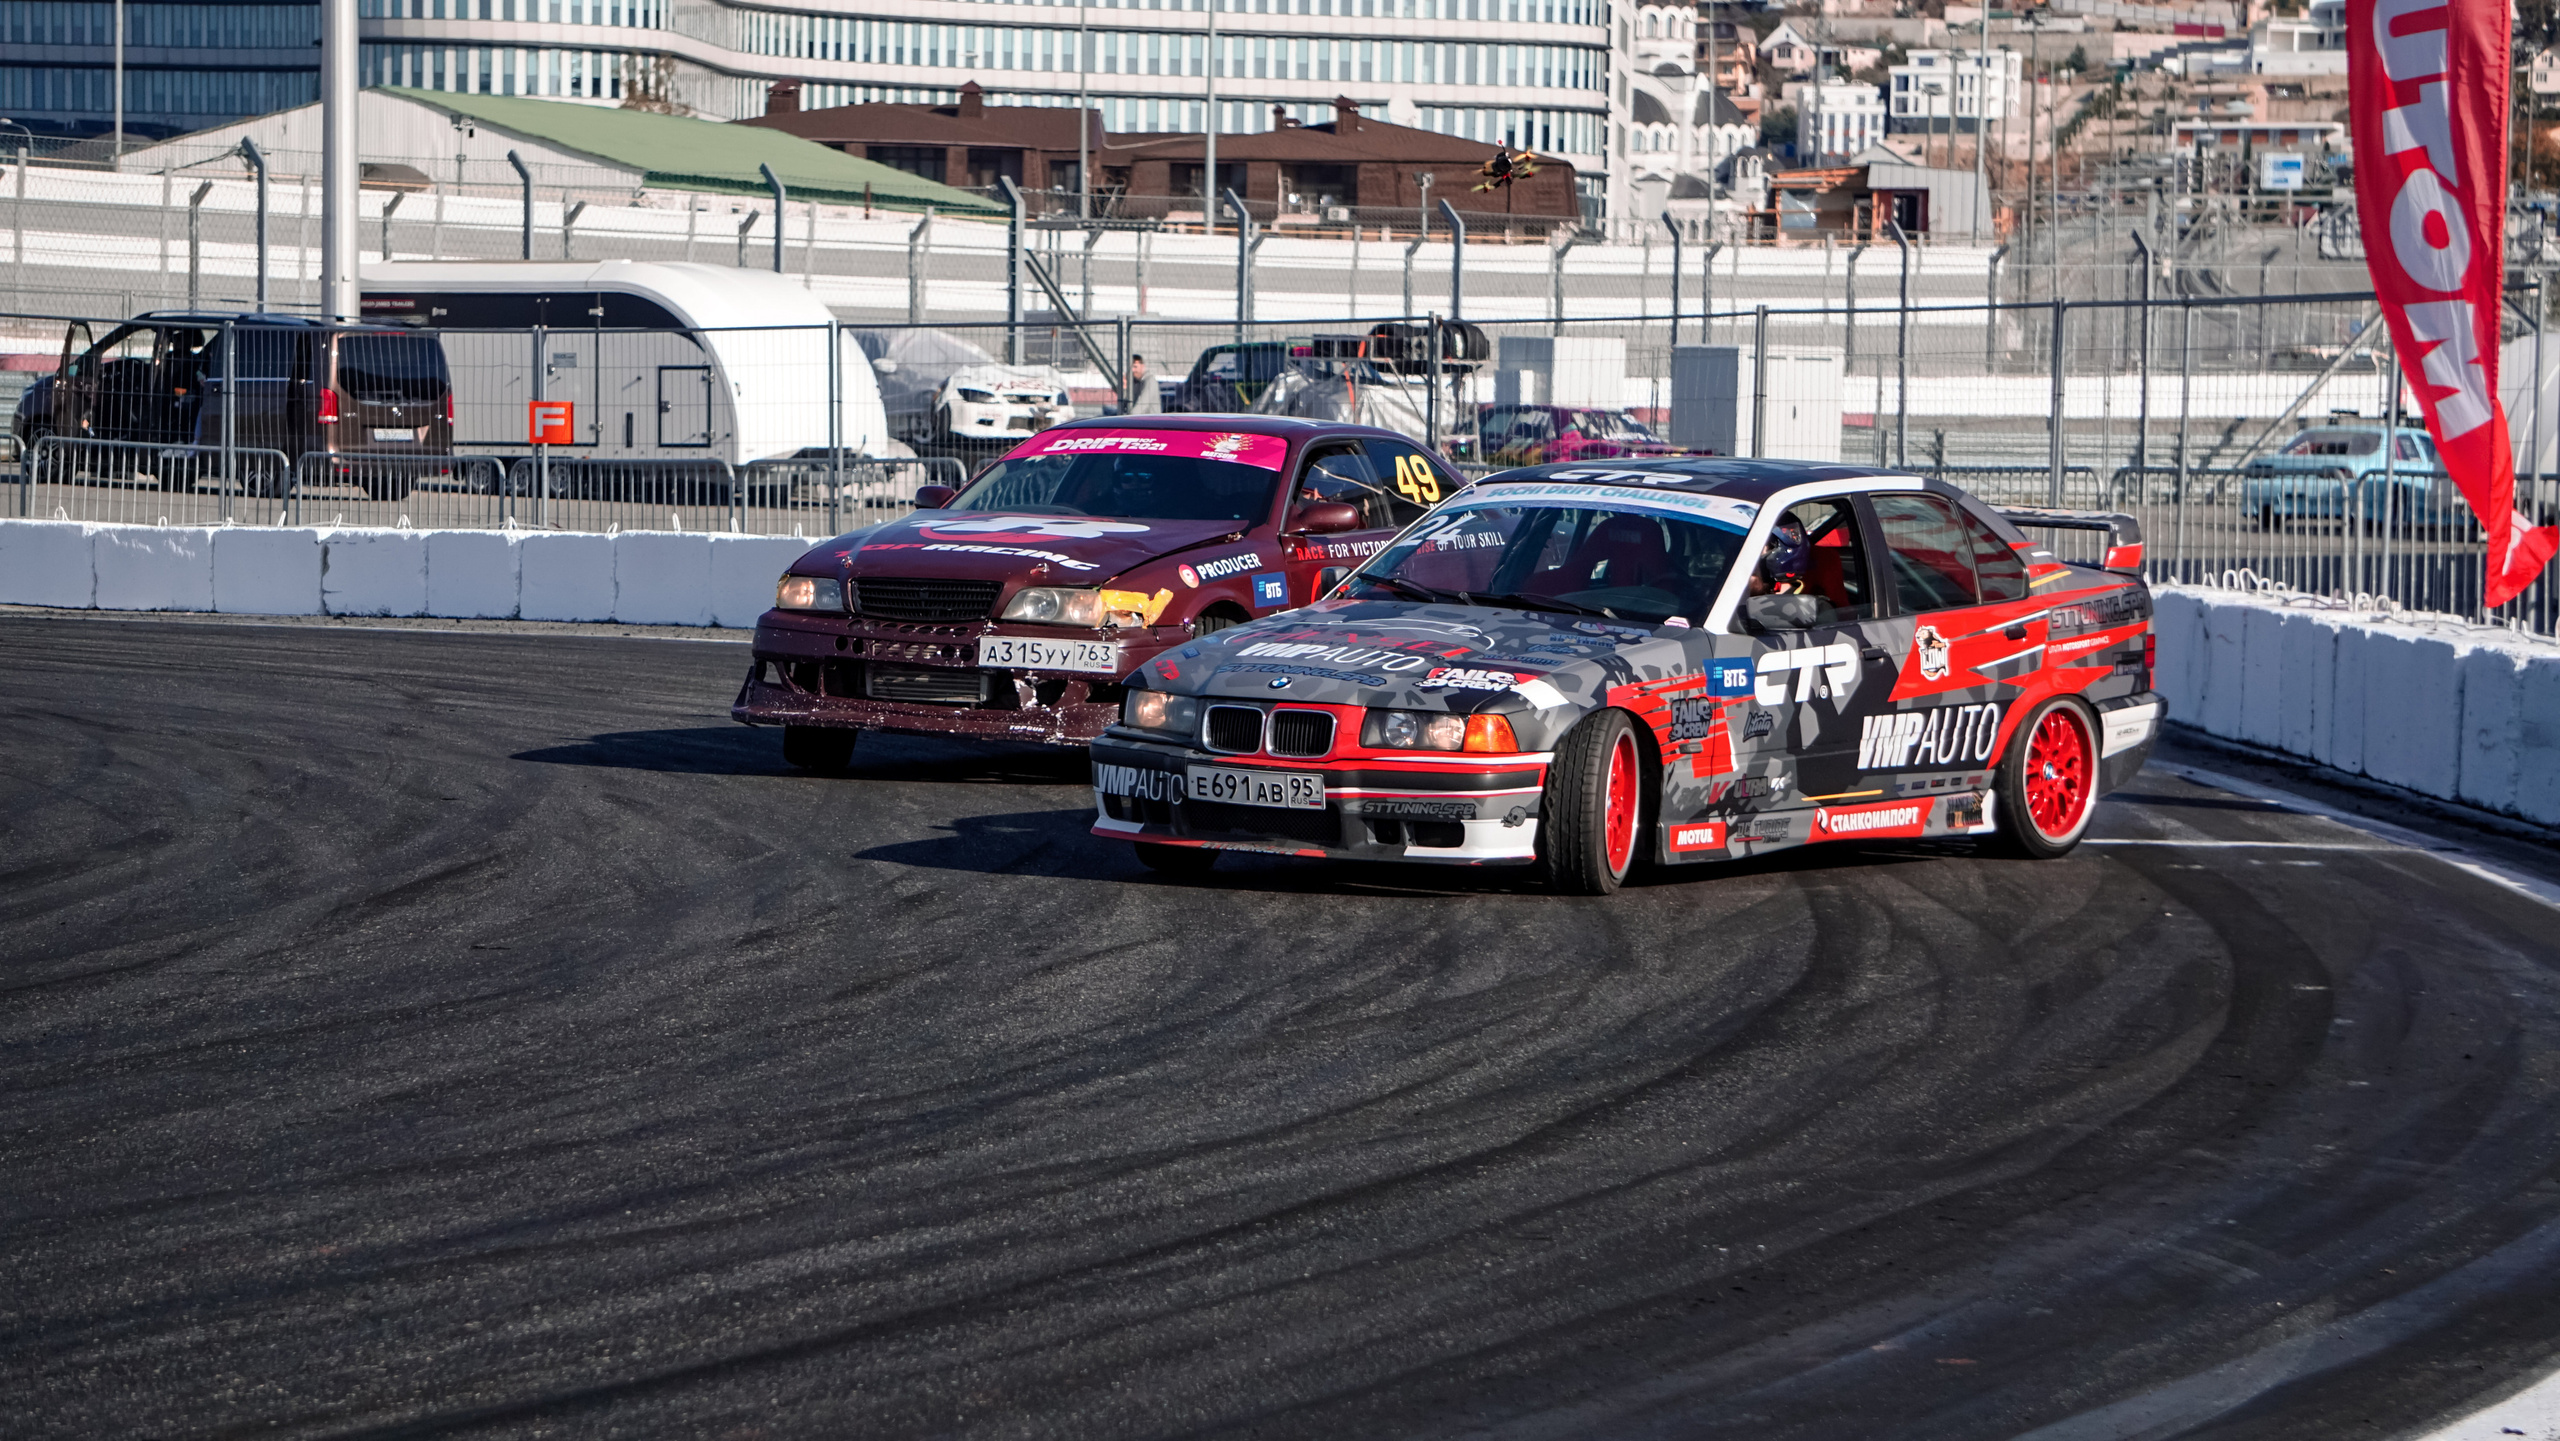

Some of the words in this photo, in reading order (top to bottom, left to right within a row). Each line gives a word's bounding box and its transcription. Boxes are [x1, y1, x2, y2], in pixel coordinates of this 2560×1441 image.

[535, 407, 565, 437] F
[1043, 438, 1140, 452] DRIFT
[1127, 442, 1168, 450] 2021
[1395, 454, 1440, 503] 49
[1549, 469, 1693, 485] CTR
[1488, 485, 1543, 498] SOCHI
[1549, 484, 1597, 498] DRIFT
[1600, 486, 1711, 509] CHALLENGE
[1395, 515, 1478, 548] 24
[1452, 533, 1477, 550] YOUR
[1478, 531, 1505, 548] SKILL
[921, 544, 1100, 571] RACING
[1296, 545, 1326, 561] RACE
[1328, 543, 1350, 558] FOR
[1351, 539, 1390, 556] VICTOR
[1196, 552, 1262, 579] PRODUCER
[1265, 581, 1282, 599] ВТБ
[1077, 644, 1111, 661] 763
[1236, 642, 1425, 671] VMPAUTO
[1083, 660, 1101, 669] RUS
[1215, 663, 1387, 687] STTUNING.SPB
[1755, 643, 1857, 706] CTR
[1447, 679, 1509, 692] CREW
[1723, 669, 1747, 688] ВТБ
[1672, 698, 1699, 724] FAIL
[1683, 721, 1710, 739] CREW
[1858, 702, 1999, 769] VMPAUTO
[1098, 763, 1187, 805] VMPAUTO
[1291, 777, 1314, 798] 95
[1291, 797, 1309, 805] RUS
[1363, 802, 1476, 815] STTUNING.SPB
[1831, 806, 1919, 833] СТАНКОИМПОРТ
[1677, 828, 1714, 846] MOTUL
